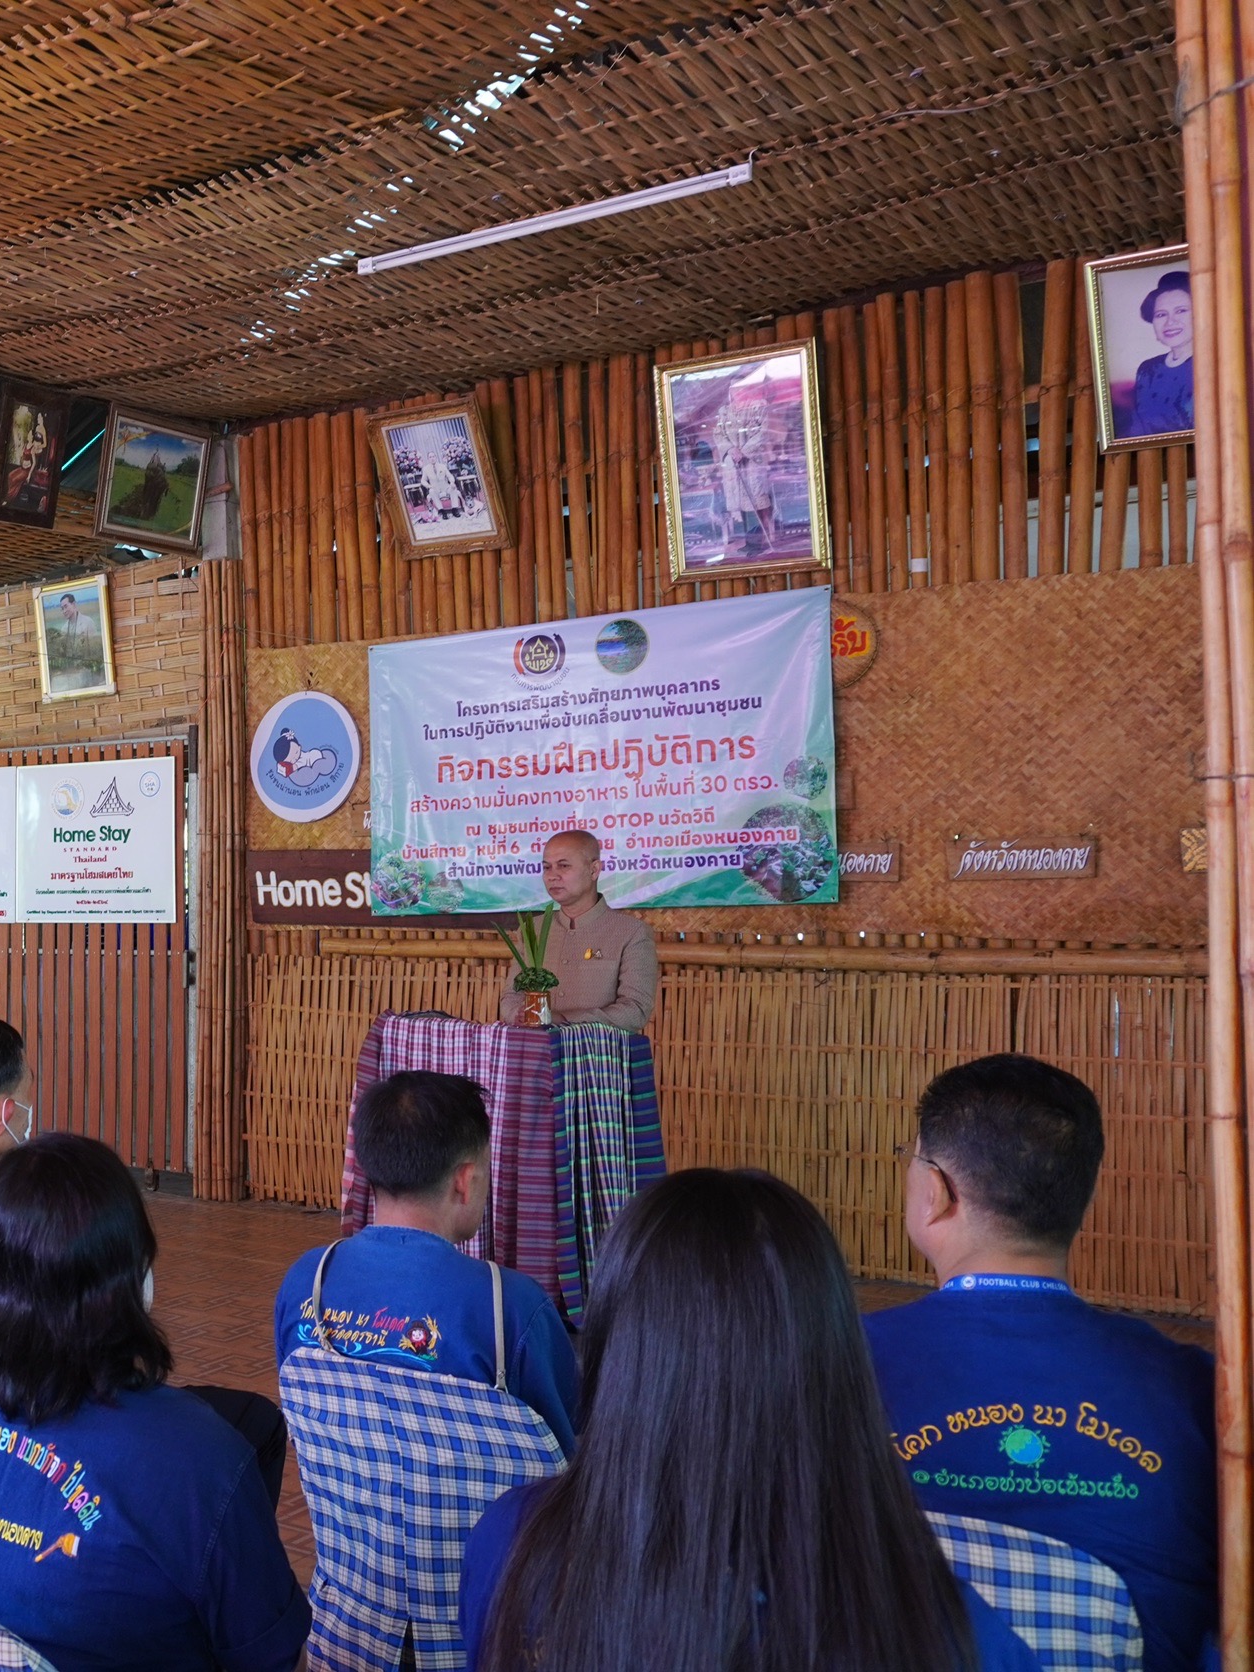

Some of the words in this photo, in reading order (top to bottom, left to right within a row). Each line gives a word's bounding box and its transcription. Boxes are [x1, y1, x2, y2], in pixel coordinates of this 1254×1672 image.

[831, 618, 867, 657] รับ
[457, 678, 721, 717] โครงการเสริมสร้างศักยภาพบุคลากร
[423, 697, 762, 741] ในการปฏิบัติงานเพื่อขับเคลื่อนงานพัฒนาชุมชน
[437, 733, 756, 783] กิจกรรมฝึกปฏิบัติการ
[410, 785, 628, 812] สร้างความมั่นคงทางอาหาร
[634, 771, 695, 798] ในพื้นที่
[701, 775, 727, 793] 30
[733, 775, 778, 791] ตรว.
[53, 827, 96, 843] Home
[99, 825, 131, 843] Stay
[466, 824, 481, 836] ณ
[488, 811, 598, 839] ชุมชนท่องเที่ยว
[603, 812, 654, 829] OTOP
[659, 805, 715, 826] นวัตวิถี
[73, 855, 107, 863] Thailand
[402, 844, 466, 860] บ้านสีกาย
[510, 841, 521, 855] 6
[626, 827, 797, 849] อำเภอเมืองหนองคาย
[954, 838, 1091, 878] จังหวัดหนองคาย
[50, 867, 134, 882] มาตรฐานโฮมสเตย์ไทย
[838, 851, 893, 876] นองคาย
[256, 870, 342, 907] Home
[345, 871, 371, 908] St
[978, 1277, 1018, 1288] FOOTBALL
[1020, 1279, 1040, 1289] CLUB
[946, 1403, 1024, 1433] หนอง
[1033, 1404, 1066, 1427] นา
[1075, 1402, 1163, 1473] โมเดล
[60, 1460, 102, 1531] ไปขุดดิน
